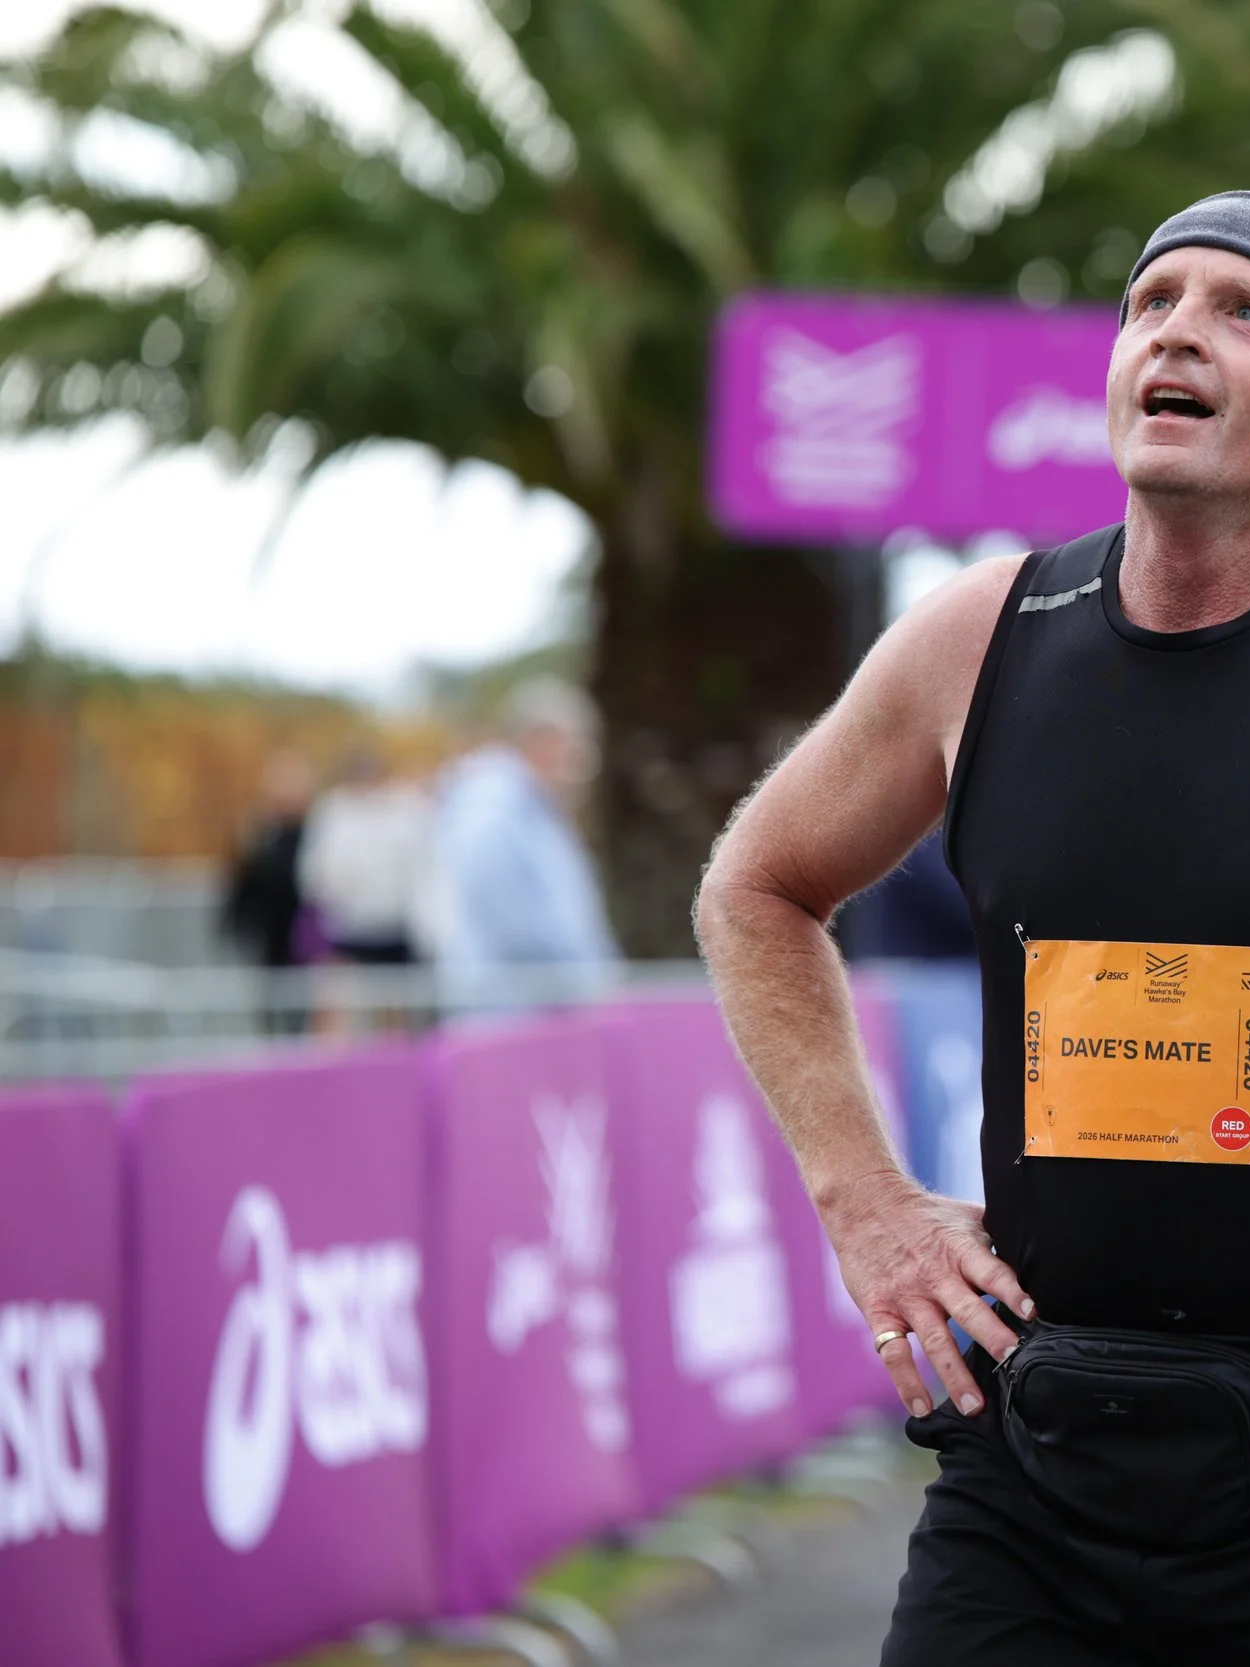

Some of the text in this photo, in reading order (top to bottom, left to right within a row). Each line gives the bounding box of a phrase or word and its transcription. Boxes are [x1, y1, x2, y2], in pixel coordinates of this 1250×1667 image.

[1106, 971, 1129, 981] asics
[1150, 979, 1180, 988] Runaway
[1144, 987, 1187, 998] Hawke's Bay
[1148, 995, 1181, 1004] Marathon
[1027, 1010, 1041, 1083] 04420
[1061, 1037, 1212, 1063] DAVE'S MATE
[1221, 1120, 1245, 1131] RED
[1077, 1131, 1179, 1144] 2026 HALF MARATHON
